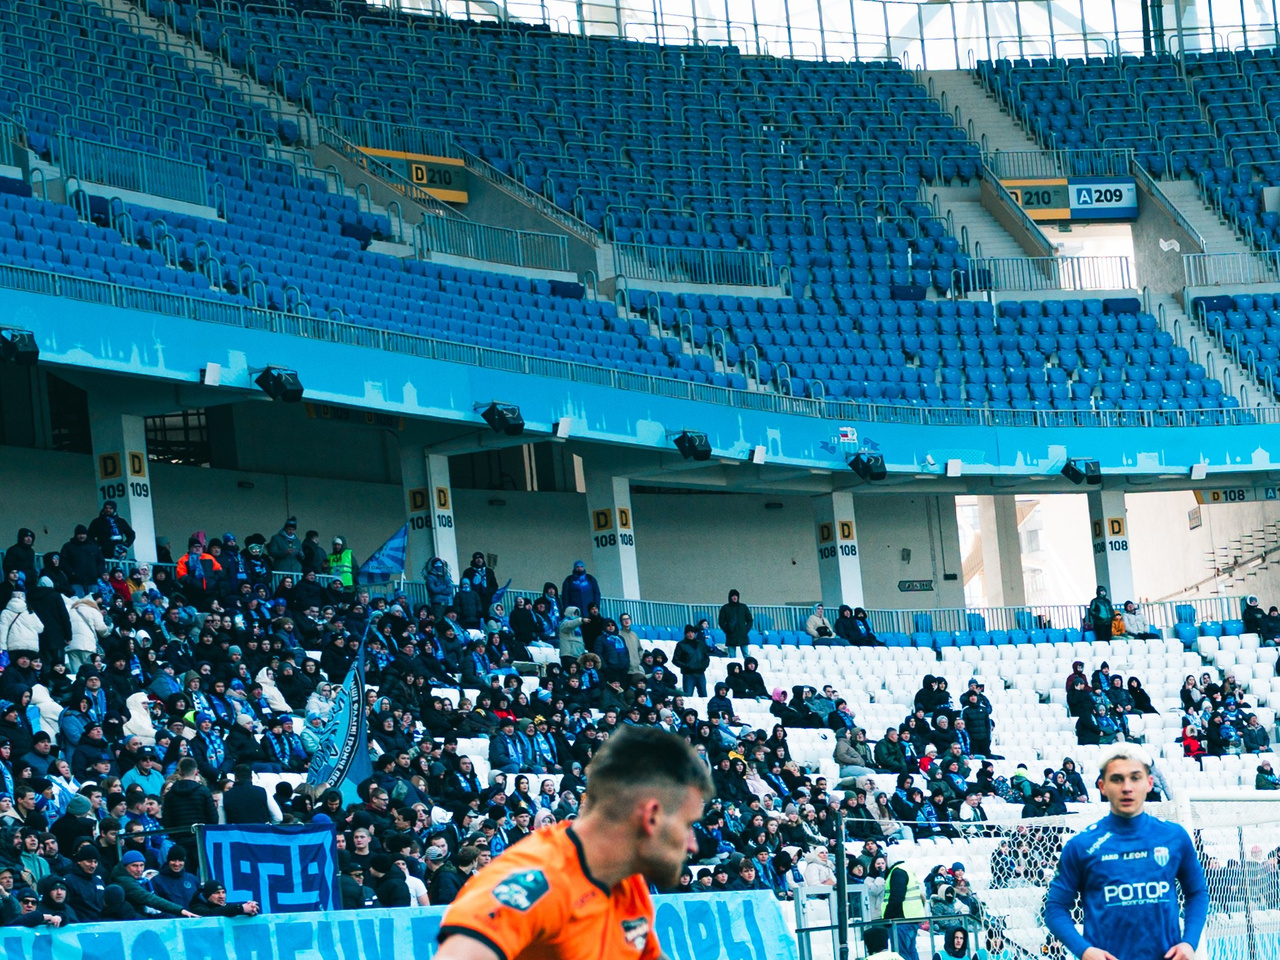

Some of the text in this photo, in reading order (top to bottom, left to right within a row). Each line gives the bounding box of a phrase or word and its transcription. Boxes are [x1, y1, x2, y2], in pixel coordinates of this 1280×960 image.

[415, 166, 452, 186] D 210
[1024, 190, 1051, 206] 210
[1079, 188, 1123, 204] A 209
[101, 455, 118, 477] D
[131, 453, 143, 475] D
[99, 482, 126, 500] 109
[129, 481, 149, 498] 109
[1212, 489, 1246, 502] D 108
[1267, 488, 1275, 499] A
[412, 490, 425, 509] D
[437, 489, 447, 508] D
[409, 515, 432, 530] 108
[436, 514, 453, 528] 108
[596, 511, 608, 529] D
[620, 510, 628, 527] D
[820, 524, 831, 541] D
[841, 522, 851, 538] D
[1110, 519, 1121, 535] D
[593, 533, 617, 548] 108
[619, 533, 634, 546] 108
[1108, 540, 1129, 551] 108
[818, 545, 837, 559] 108
[839, 544, 857, 556] 108
[1123, 851, 1148, 860] LEON
[1104, 881, 1170, 902] РОТОР
